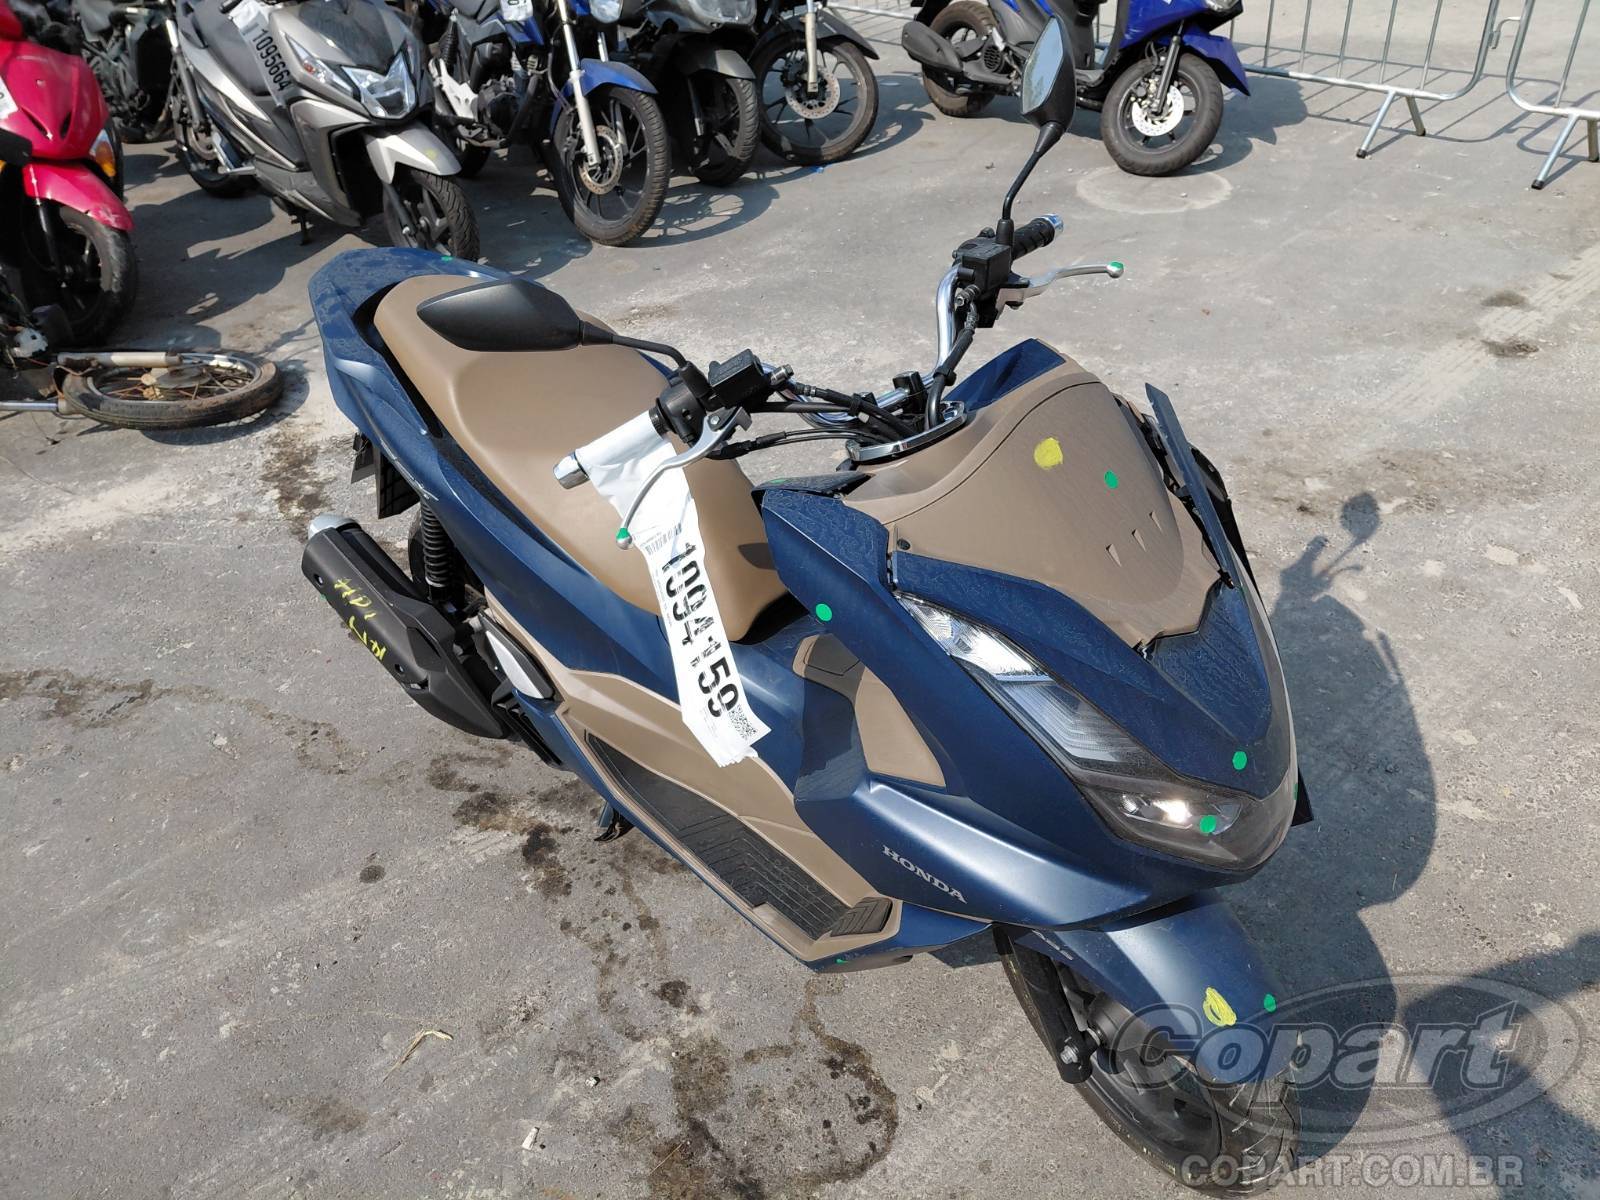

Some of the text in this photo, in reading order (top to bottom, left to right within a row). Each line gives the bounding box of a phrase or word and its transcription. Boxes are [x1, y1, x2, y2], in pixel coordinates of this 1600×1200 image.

[253, 28, 292, 92] 1095664
[662, 543, 739, 718] 1094159
[882, 844, 968, 905] HONDA
